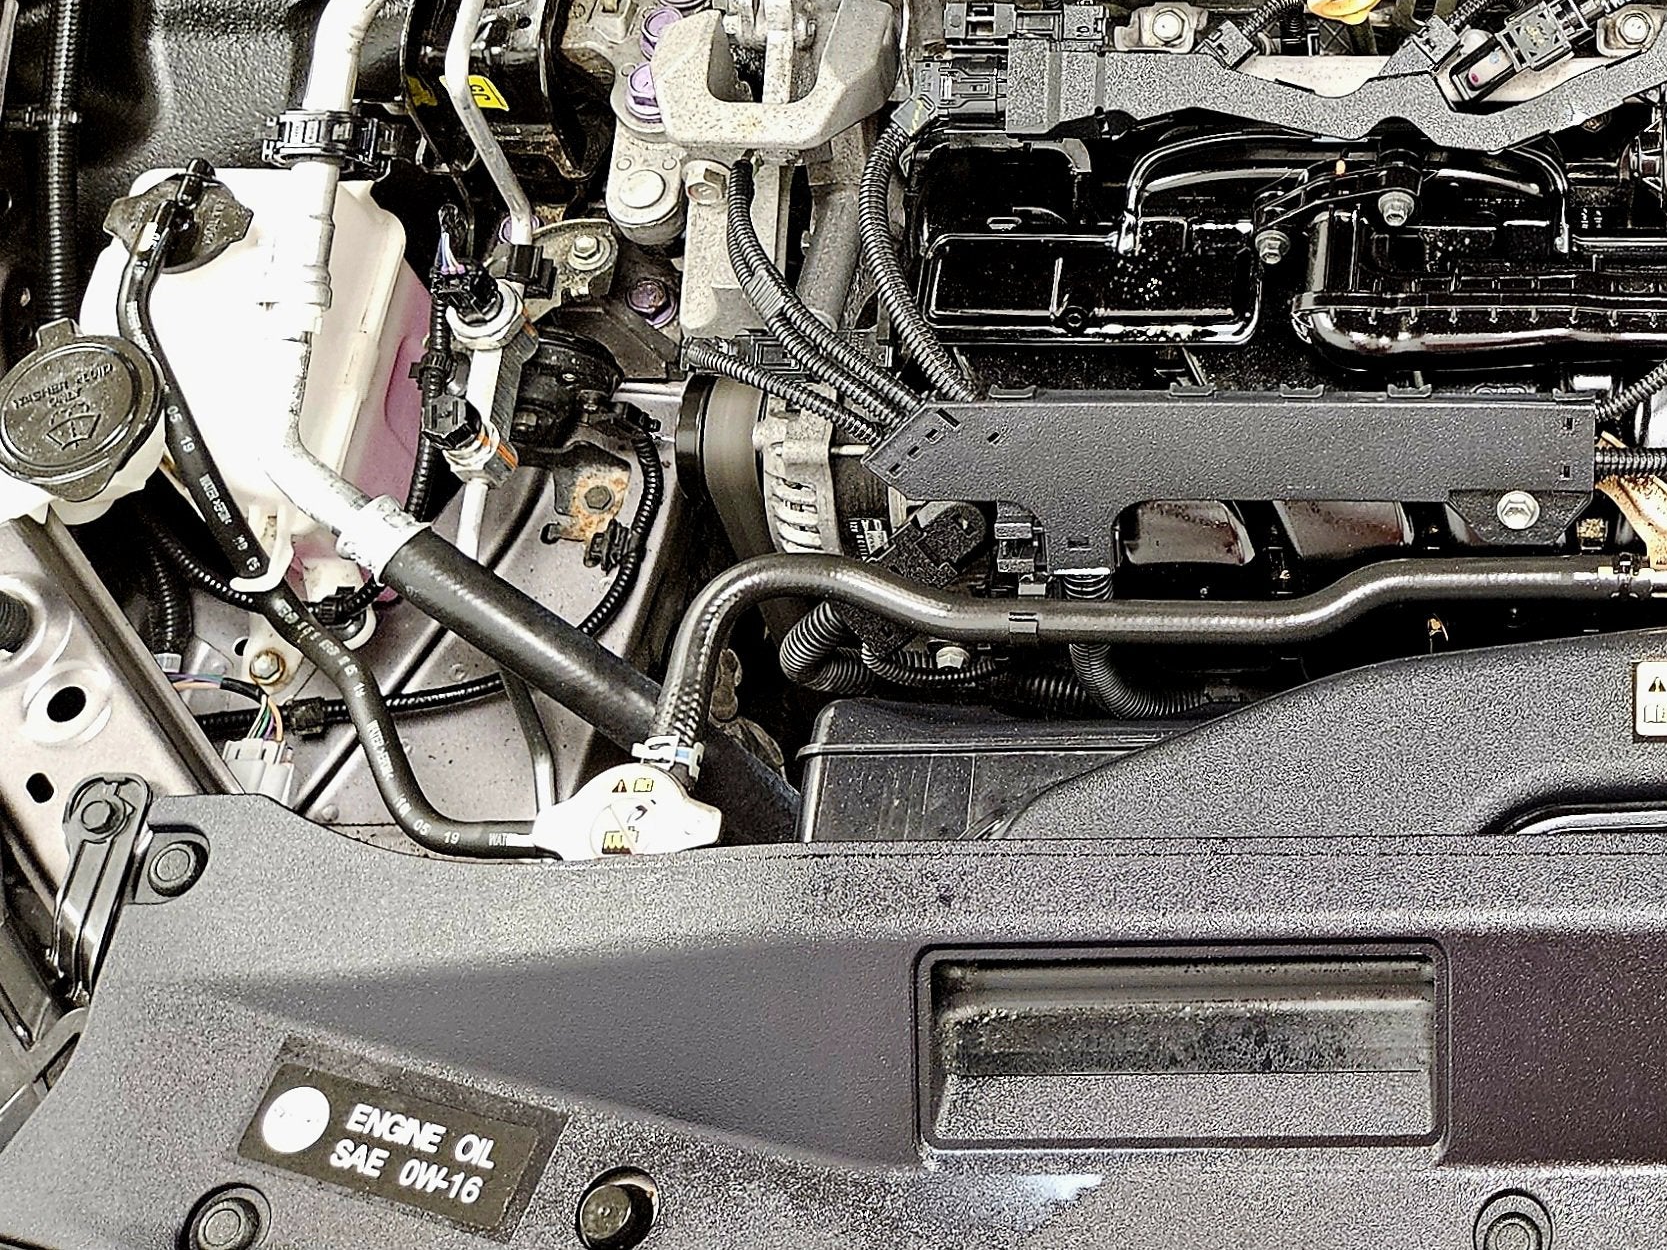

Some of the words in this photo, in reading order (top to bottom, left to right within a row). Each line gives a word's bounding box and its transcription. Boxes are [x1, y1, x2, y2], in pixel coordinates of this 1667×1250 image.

[166, 405, 183, 423] 05
[180, 435, 196, 453] 19
[413, 819, 432, 836] 05
[443, 831, 461, 845] 19
[345, 1103, 447, 1154] ENGINE
[454, 1134, 495, 1170] OIL
[329, 1139, 391, 1179] SAE
[399, 1158, 484, 1204] 0W-16
